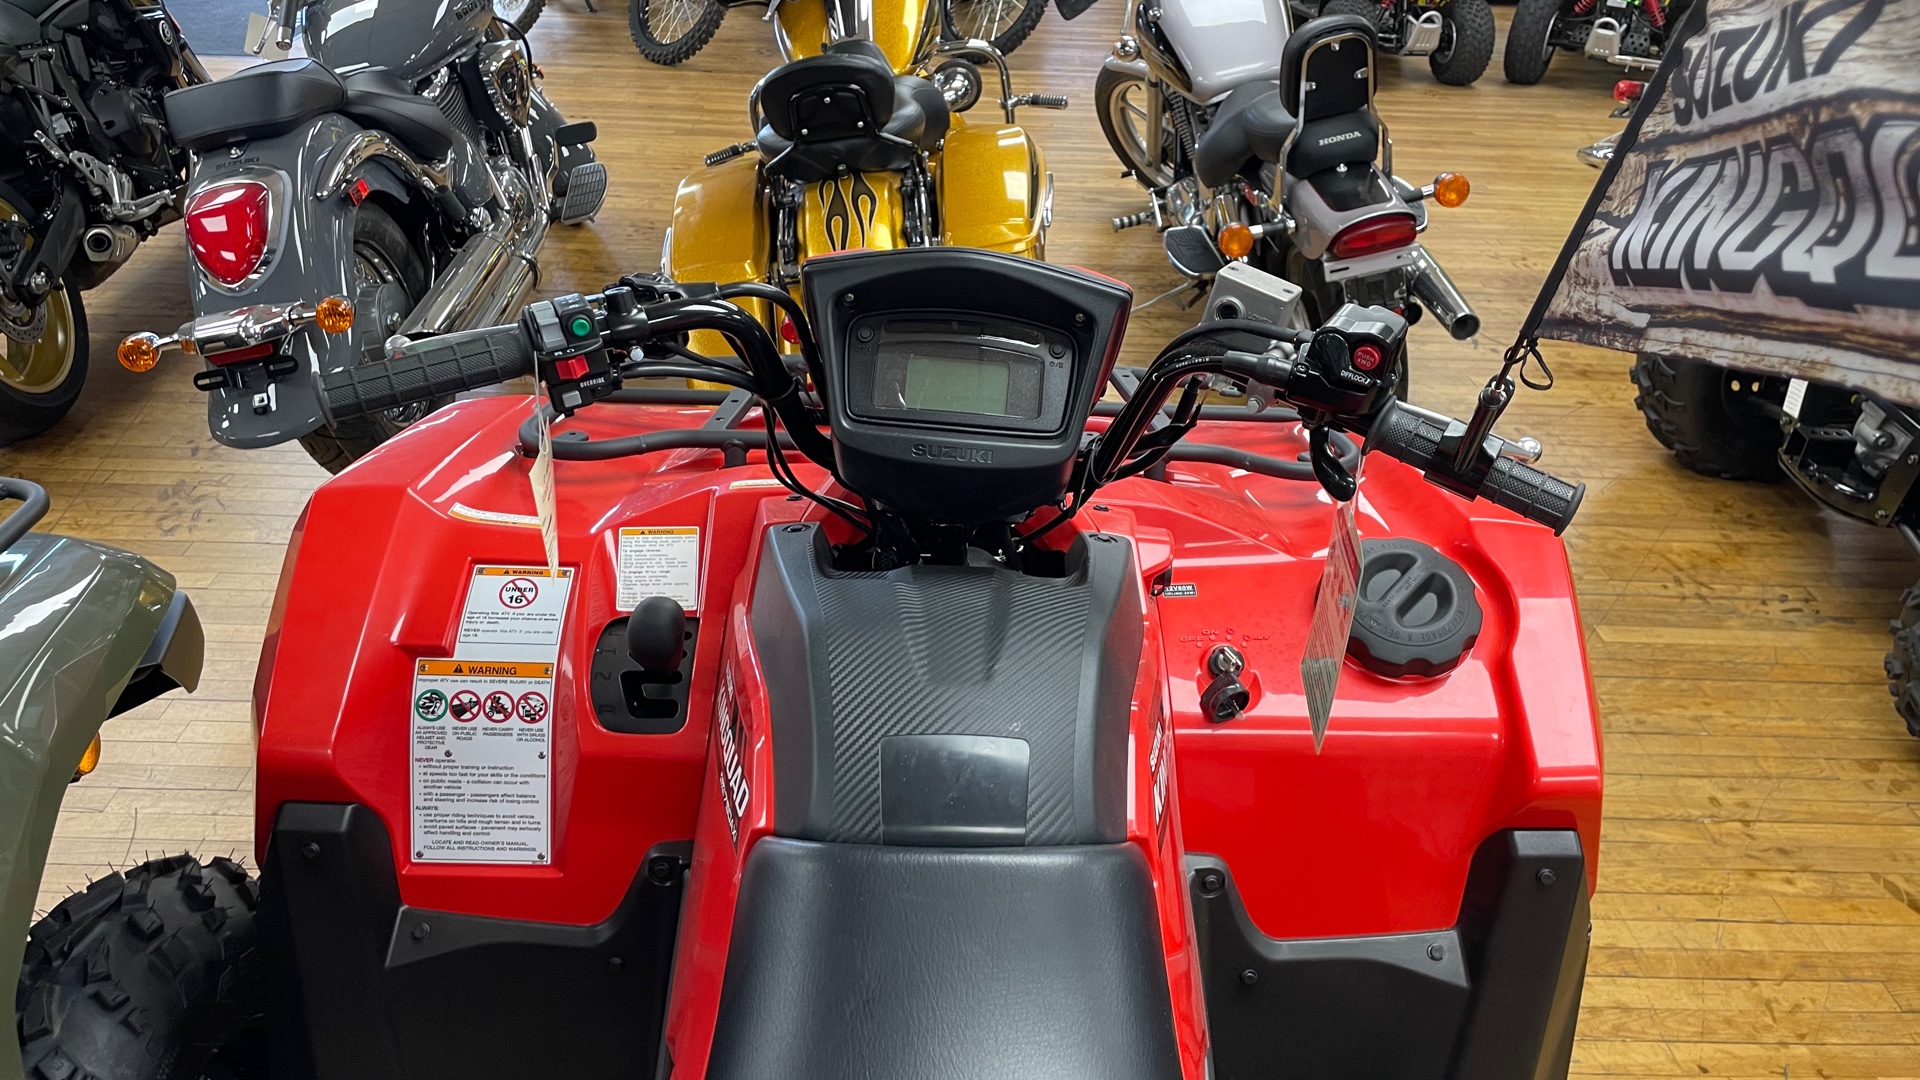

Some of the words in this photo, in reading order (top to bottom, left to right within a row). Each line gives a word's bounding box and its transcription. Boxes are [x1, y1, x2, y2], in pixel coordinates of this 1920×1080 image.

[1318, 130, 1362, 146] HONDA
[216, 156, 260, 170] SUZUKI
[1357, 351, 1375, 362] PUSH
[1357, 358, 1372, 367] 4WD
[580, 376, 605, 388] OVERRIDE
[1340, 369, 1366, 383] DIFFLOCK
[911, 443, 994, 464] SUZUKI
[508, 595, 524, 604] 16
[468, 666, 517, 675] WARNING
